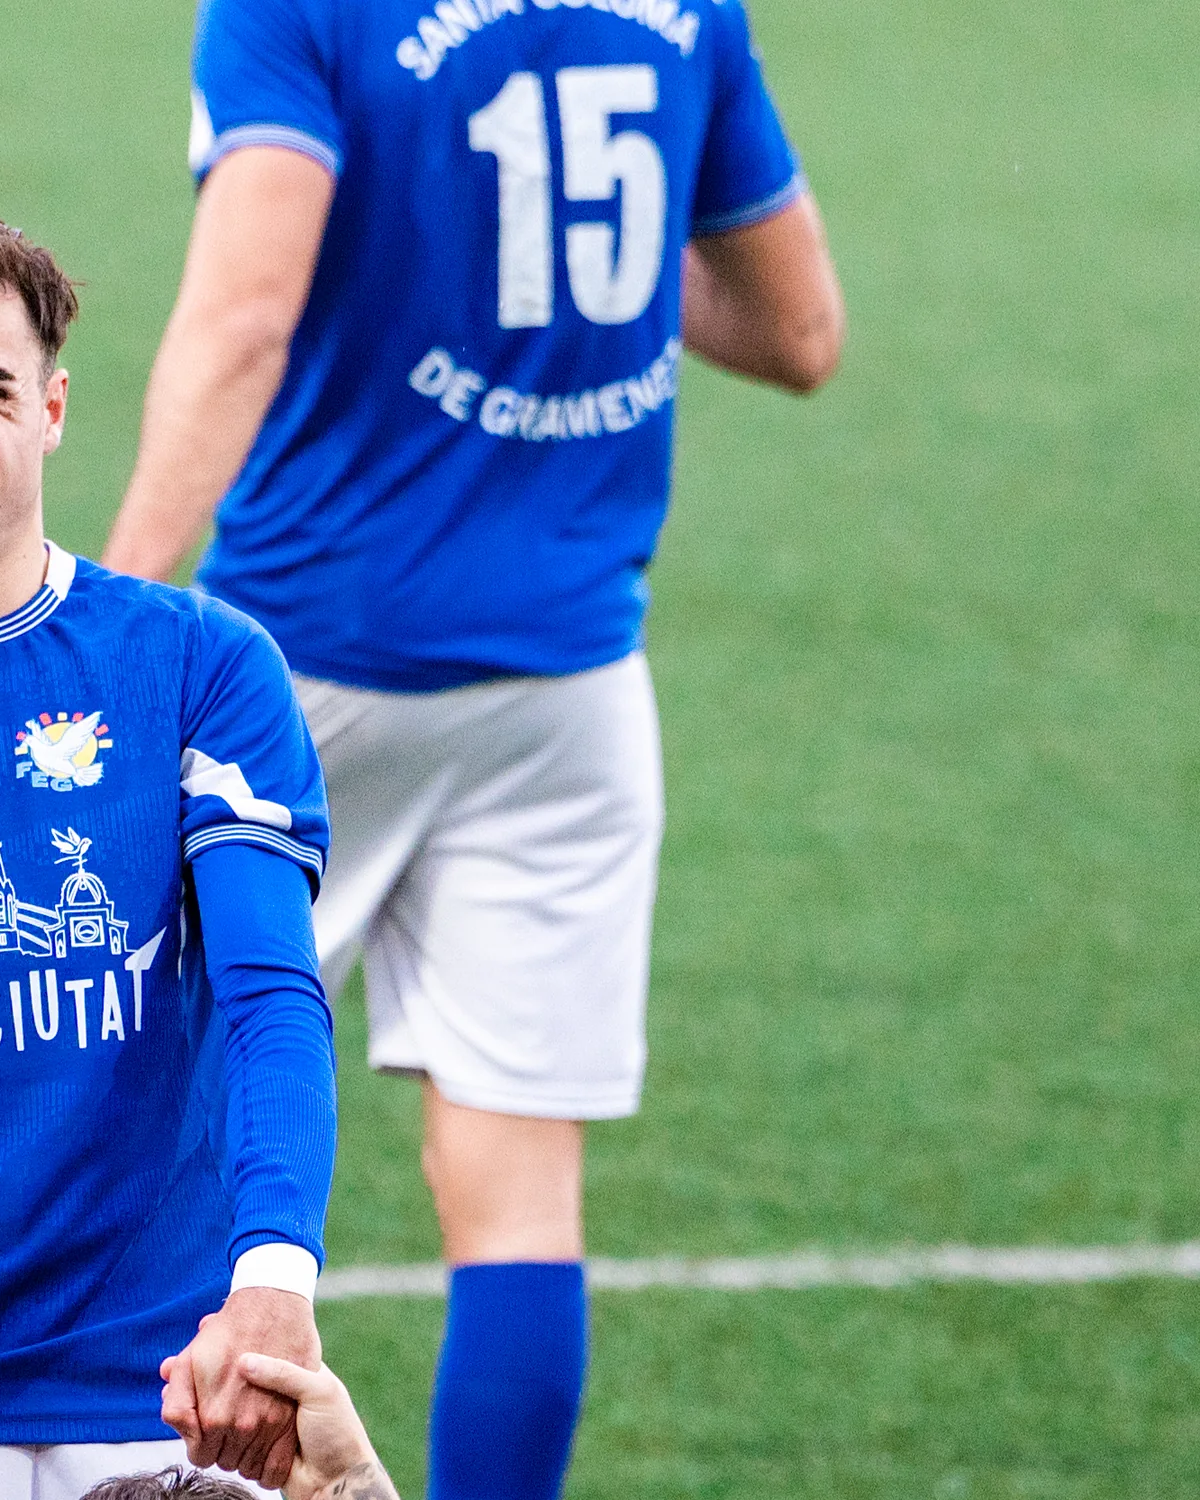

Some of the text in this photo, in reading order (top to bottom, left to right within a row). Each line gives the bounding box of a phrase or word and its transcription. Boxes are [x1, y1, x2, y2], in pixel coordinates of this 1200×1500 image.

[396, 0, 526, 81] SAN
[468, 64, 667, 329] 15
[408, 346, 487, 421] DE
[15, 761, 74, 792] FEG
